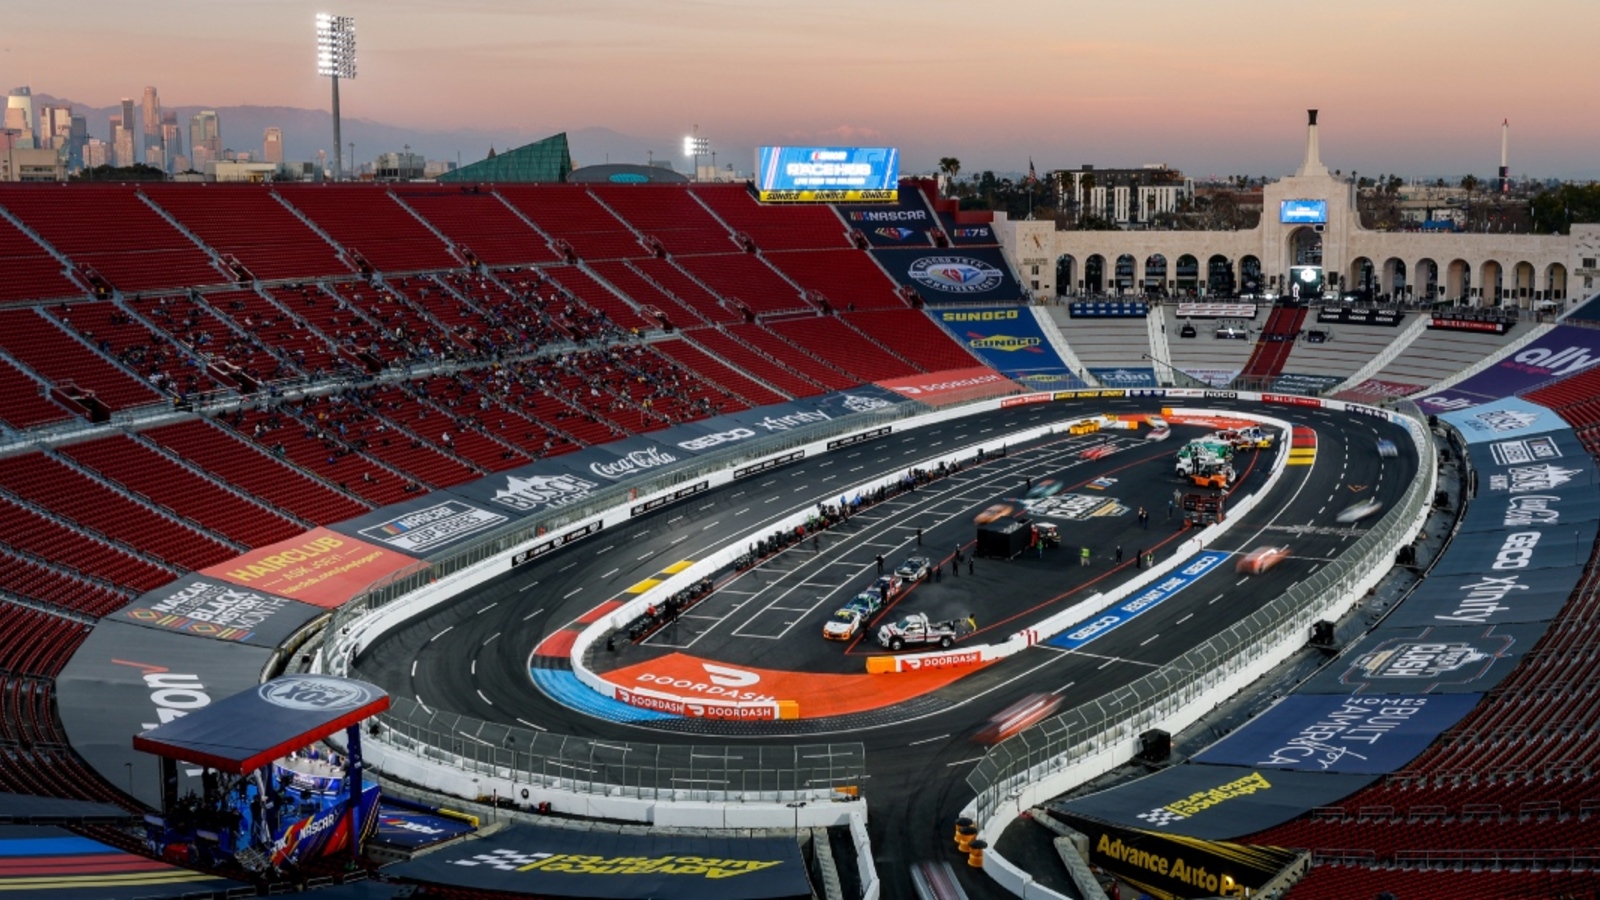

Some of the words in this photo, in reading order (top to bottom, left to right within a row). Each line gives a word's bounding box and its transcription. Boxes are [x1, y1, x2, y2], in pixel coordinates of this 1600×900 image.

[868, 210, 926, 221] NASCAR
[943, 310, 1018, 321] SUNOCO
[971, 337, 1039, 348] SUNOCO
[1514, 346, 1592, 376] ally
[677, 428, 756, 450] GEICO
[496, 474, 598, 511] BUSCH
[399, 506, 457, 529] NASCAR
[406, 529, 436, 543] CUP
[437, 514, 481, 534] SERIES
[226, 536, 344, 582] HAIRCLUB
[1492, 531, 1542, 569] GEICO
[1182, 555, 1219, 575] GEICO
[151, 581, 213, 613] NASCAR
[186, 588, 255, 622] BLACK
[210, 593, 266, 627] HISTORY
[231, 596, 291, 630] MONTH
[1067, 615, 1121, 640] GEICO
[924, 653, 977, 667] DOORDASH
[1383, 644, 1447, 676] CLASH
[273, 685, 345, 707] FOX
[636, 673, 775, 702] DOORDASH
[631, 694, 684, 713] DOORDASH
[708, 707, 771, 717] DOORDASH
[1346, 697, 1428, 706] HOMES
[1256, 704, 1373, 765] AMERICA
[1340, 707, 1420, 745] BUILT
[1183, 778, 1272, 815] Advance
[299, 814, 334, 841] NASCAR
[541, 863, 746, 879] Advance
[561, 855, 676, 866] Parts
[676, 856, 784, 871] Auto
[1097, 834, 1169, 874] Advance
[1169, 858, 1218, 892] Auto
